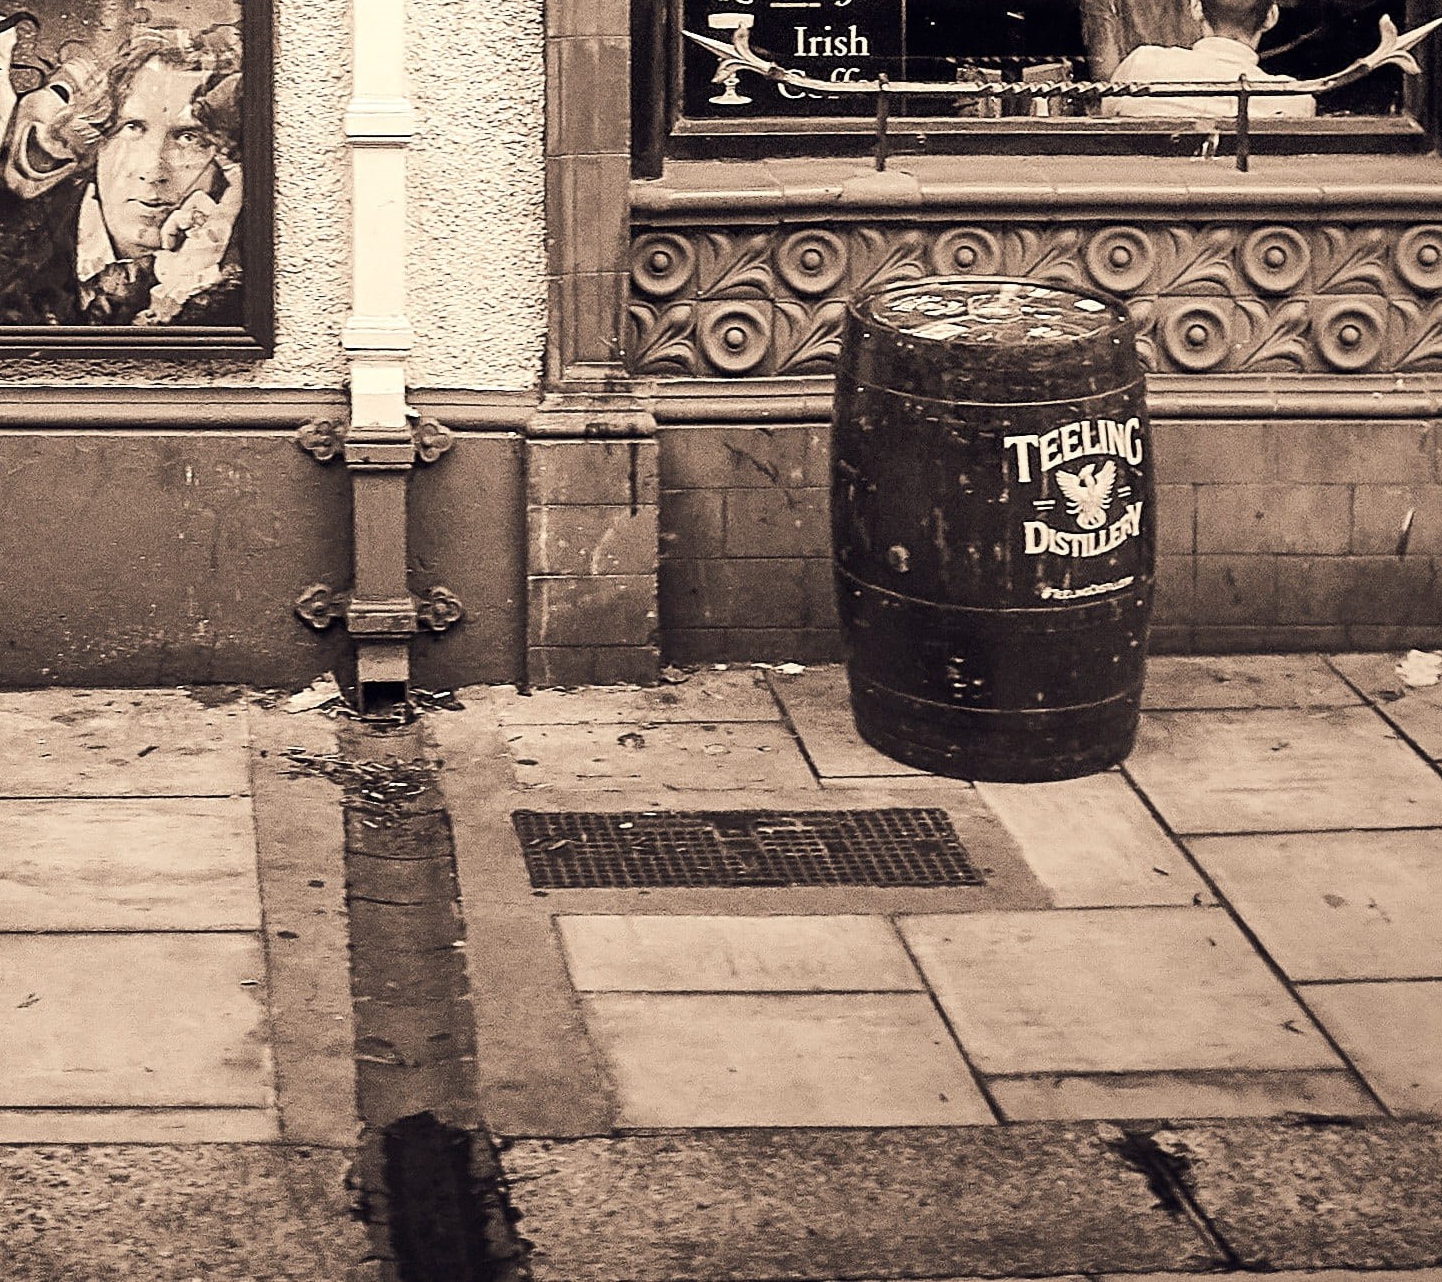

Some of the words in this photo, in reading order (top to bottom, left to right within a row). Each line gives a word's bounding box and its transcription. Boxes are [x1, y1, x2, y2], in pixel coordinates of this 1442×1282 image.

[794, 25, 870, 56] Irish
[1003, 417, 1143, 483] TEELING
[1023, 501, 1144, 557] DISTILLERY
